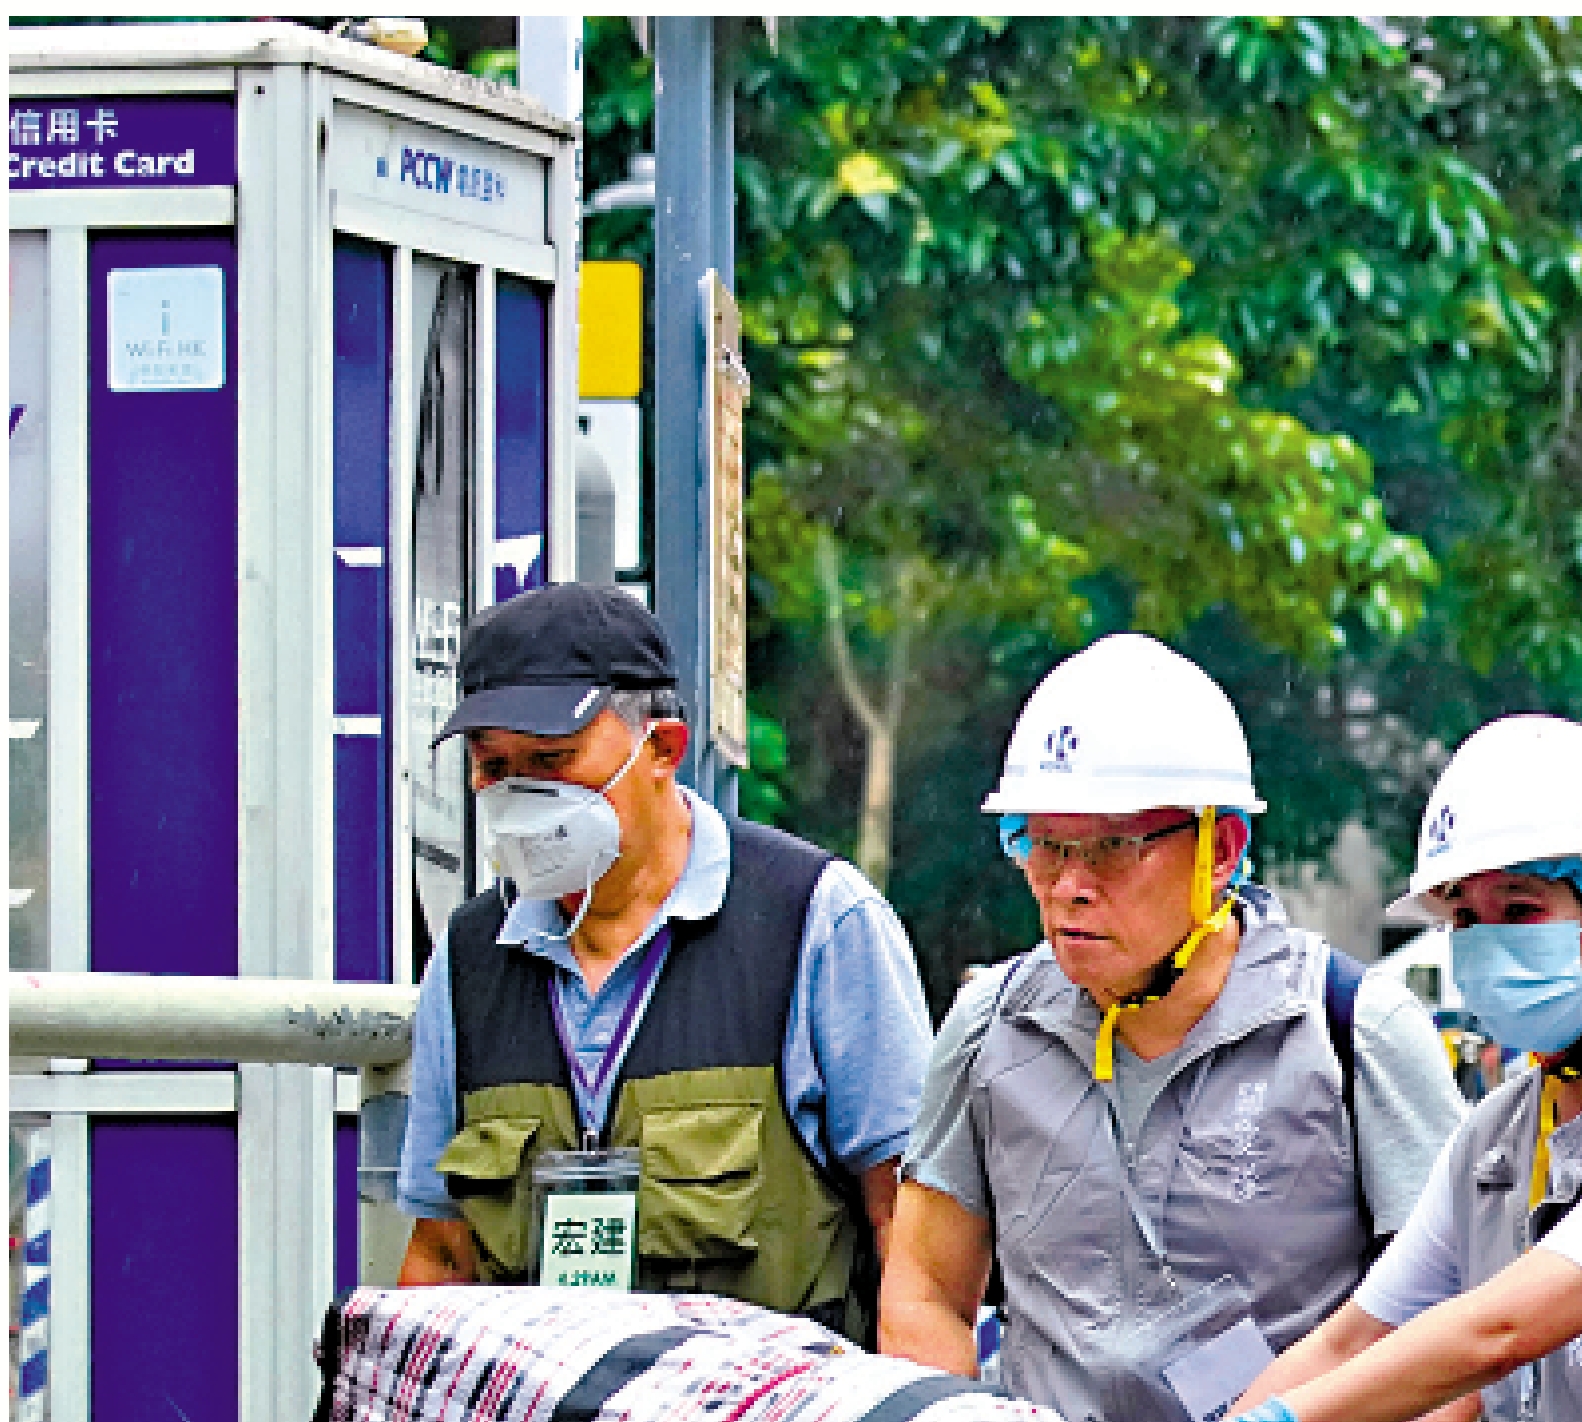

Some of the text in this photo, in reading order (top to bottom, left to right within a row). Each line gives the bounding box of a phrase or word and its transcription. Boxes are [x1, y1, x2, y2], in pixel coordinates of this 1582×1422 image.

[9, 107, 119, 146] 信用卡
[114, 148, 195, 177] Card
[400, 145, 454, 194] PCCW
[551, 1217, 628, 1257] 宏建
